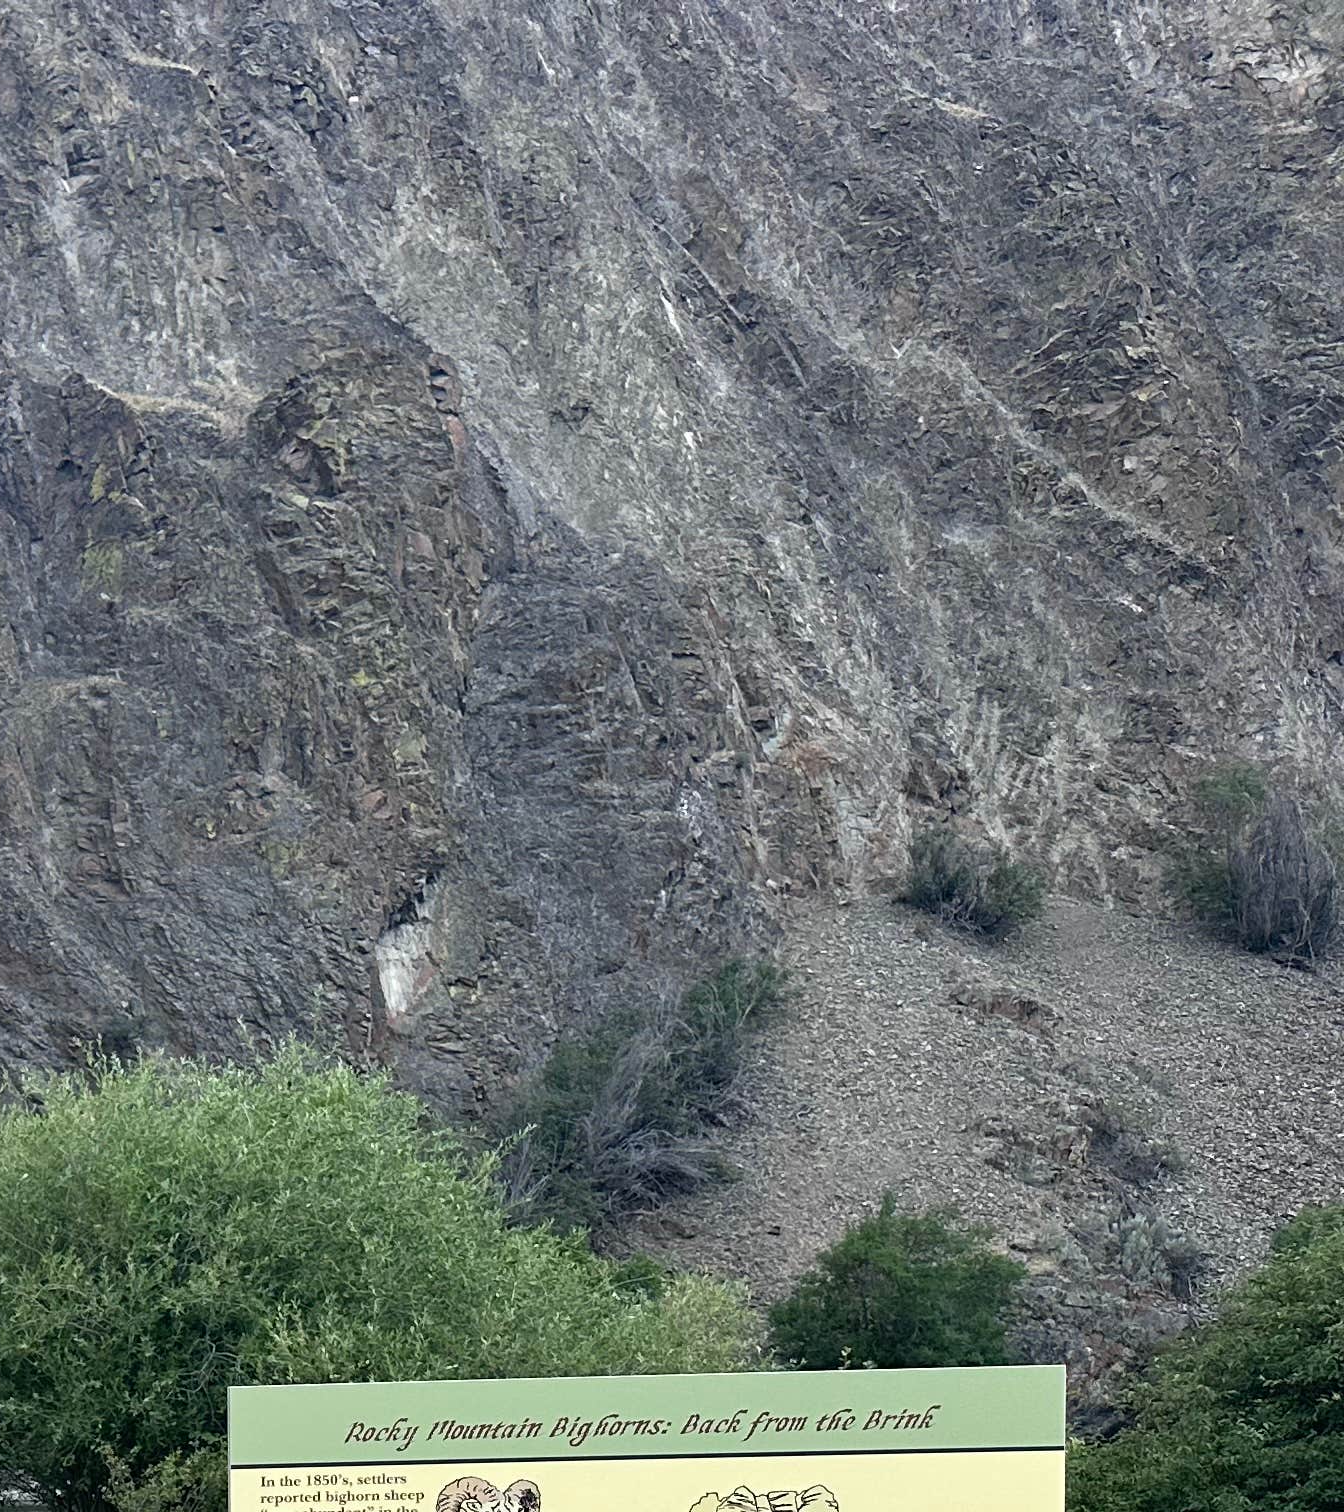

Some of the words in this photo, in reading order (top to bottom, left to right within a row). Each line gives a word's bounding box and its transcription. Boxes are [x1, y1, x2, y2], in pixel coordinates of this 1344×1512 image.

[344, 1418, 419, 1451] Rocky
[426, 1419, 543, 1445] Mountain
[548, 1413, 672, 1448] Bighorns:
[680, 1410, 743, 1437] Back
[743, 1410, 806, 1442] from
[815, 1411, 857, 1434] the
[863, 1404, 943, 1432] Brink
[262, 1477, 275, 1487] In
[280, 1476, 301, 1486] the
[358, 1474, 406, 1484] settlers
[261, 1491, 320, 1507] reported
[326, 1491, 380, 1505] bighorn
[385, 1490, 424, 1503] sheep
